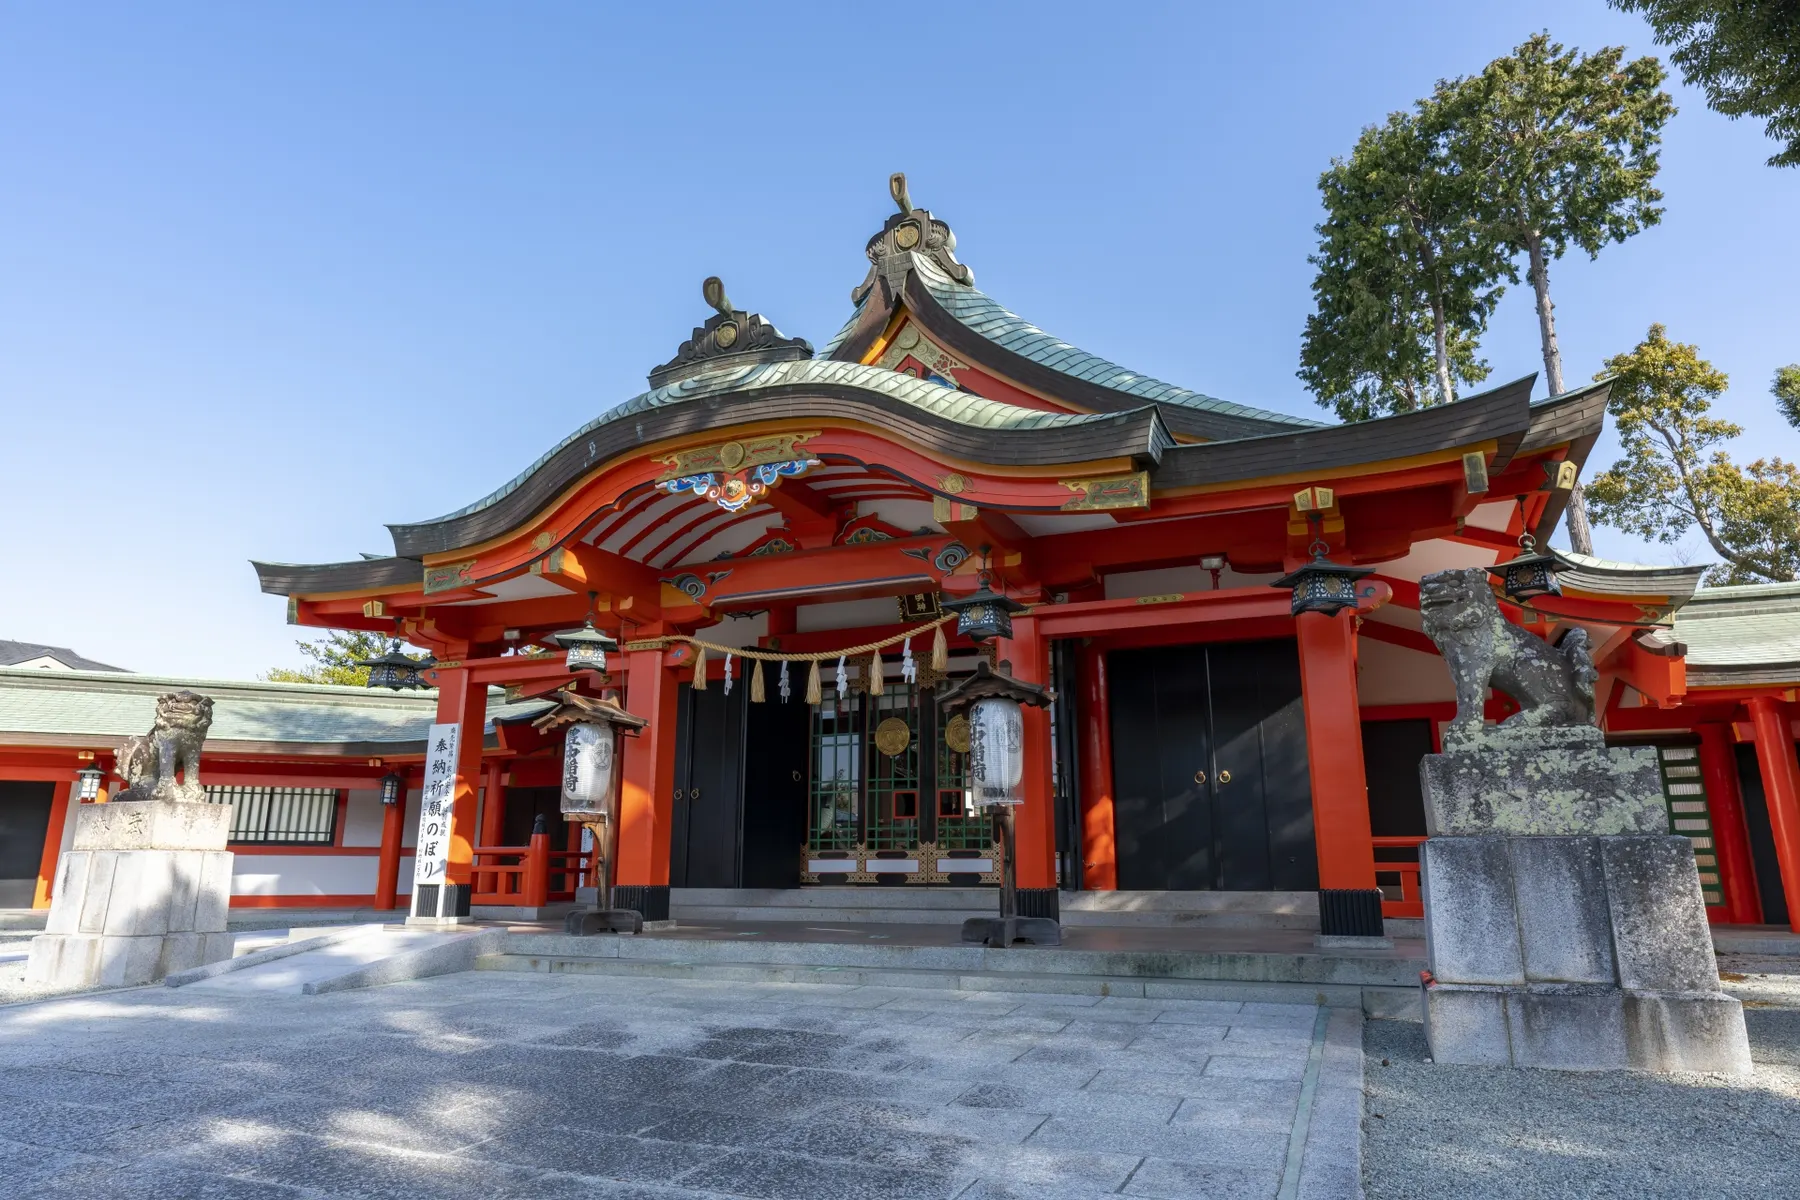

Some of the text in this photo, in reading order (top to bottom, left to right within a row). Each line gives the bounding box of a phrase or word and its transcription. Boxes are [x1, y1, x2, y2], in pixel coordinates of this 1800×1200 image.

[424, 738, 448, 879] 奉納祈願のぼり
